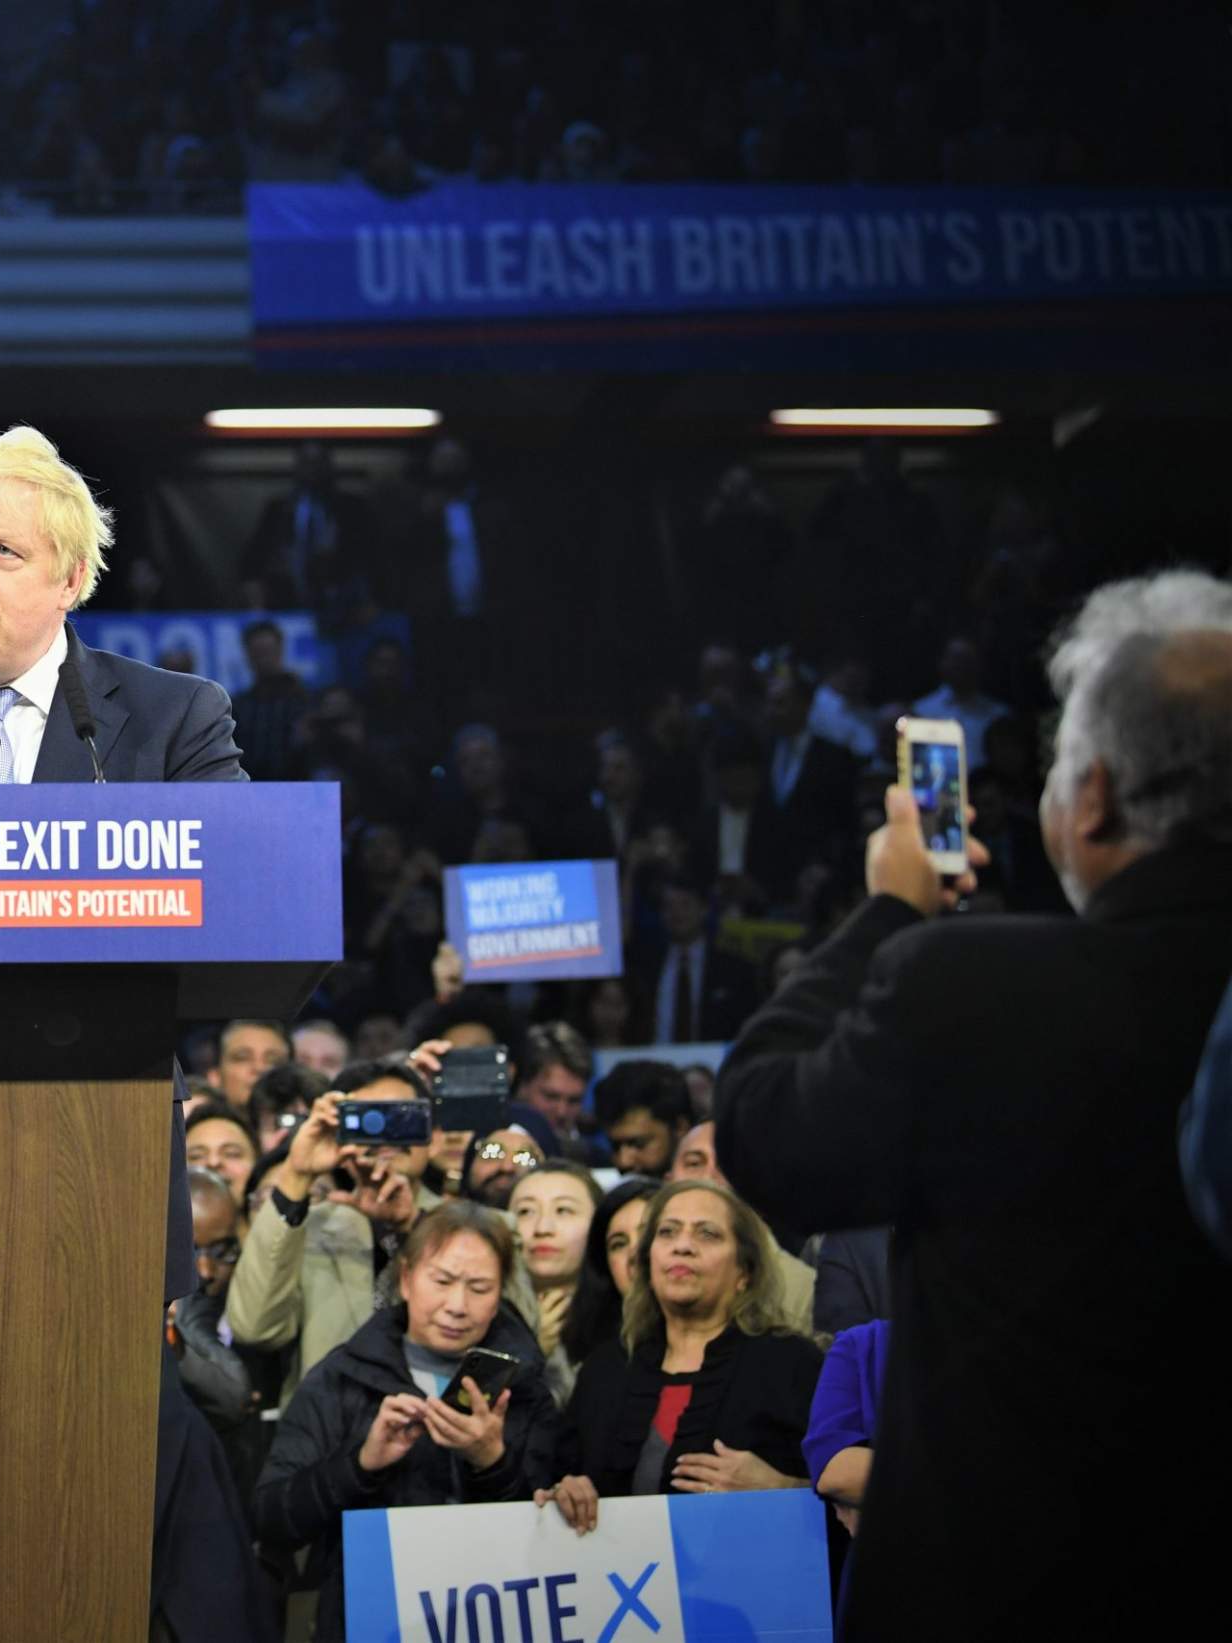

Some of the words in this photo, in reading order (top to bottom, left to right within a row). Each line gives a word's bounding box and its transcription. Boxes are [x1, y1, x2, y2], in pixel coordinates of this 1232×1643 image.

[354, 216, 655, 305] UNLEASH
[669, 208, 985, 297] BRITAIN'S
[97, 819, 203, 870] DONE
[78, 888, 191, 917] POTENTIAL
[466, 871, 558, 902] WORKING
[467, 896, 565, 930] MAJORITY
[468, 920, 600, 962] GOVERNMENT
[419, 1573, 583, 1643] VOTE
